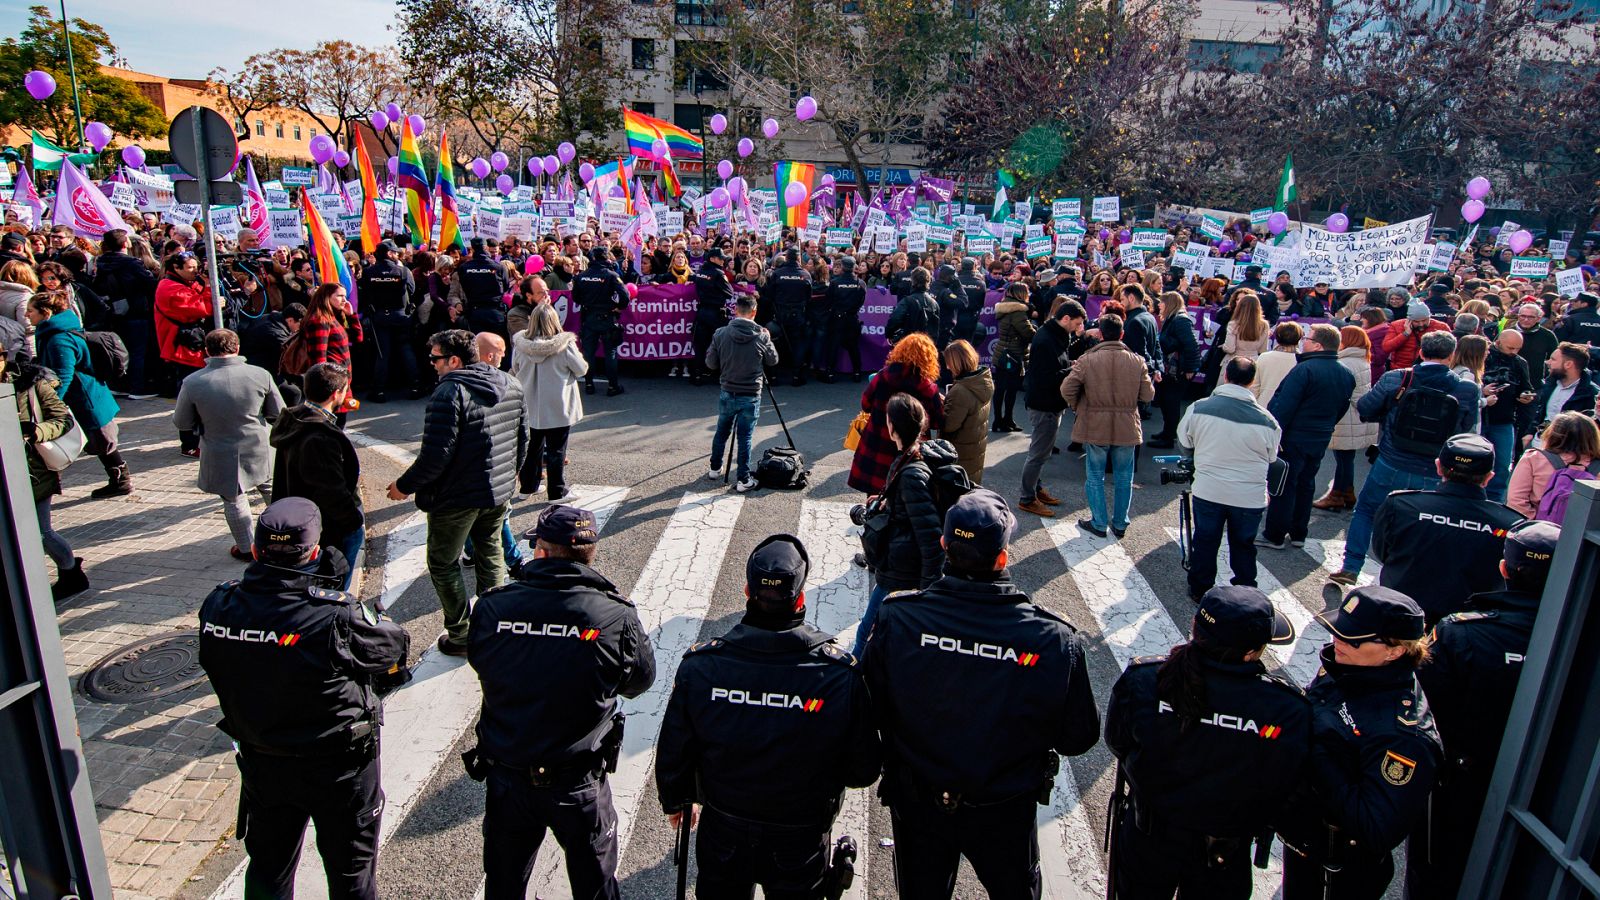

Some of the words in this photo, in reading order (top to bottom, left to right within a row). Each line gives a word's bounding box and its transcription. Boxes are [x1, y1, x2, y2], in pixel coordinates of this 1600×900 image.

[832, 169, 902, 182] ORTPEDIA
[1308, 228, 1356, 243] MUJERES
[1315, 242, 1330, 252] EL
[1309, 251, 1333, 264] POR
[1336, 253, 1348, 264] LA
[1355, 260, 1413, 276] POPULAR
[630, 298, 698, 313] feminist
[867, 305, 894, 314] DERE
[626, 318, 693, 335] socieda
[860, 325, 885, 335] ASO
[616, 341, 696, 358] GUALDA
[1418, 512, 1493, 534] POLICIA
[954, 528, 975, 540] CNP
[1526, 551, 1550, 561] CNP
[761, 578, 782, 586] CNP
[1200, 607, 1216, 625] CNP
[203, 622, 279, 644] POLICIA
[496, 620, 581, 638] POLICIA
[920, 633, 1019, 663] POLICIA
[711, 687, 804, 709] POLICIA
[1158, 700, 1259, 734] PLICIA
